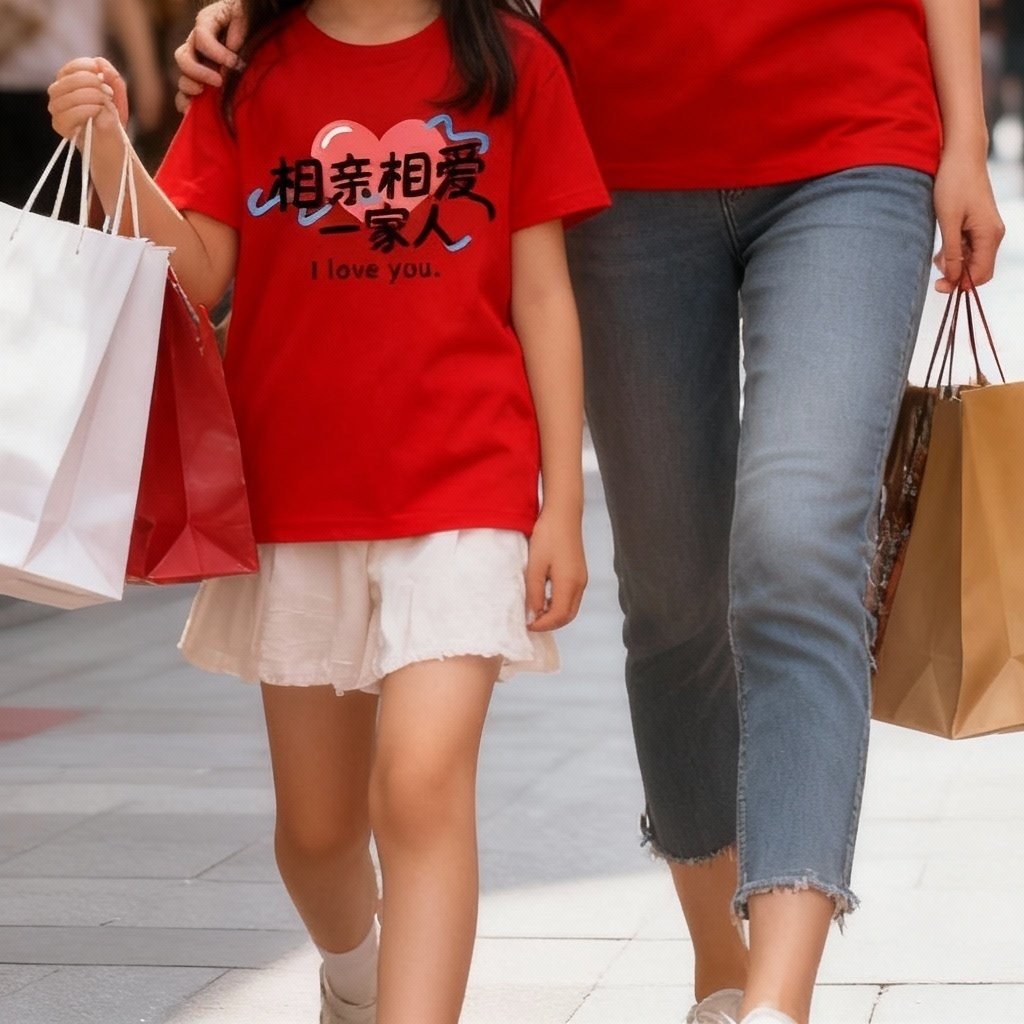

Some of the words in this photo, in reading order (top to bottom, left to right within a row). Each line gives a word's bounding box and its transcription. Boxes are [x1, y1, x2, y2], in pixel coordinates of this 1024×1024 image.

[269, 141, 496, 222] 相亲相爱
[319, 202, 455, 253] 一家人
[310, 260, 318, 281] I
[327, 257, 379, 280] love
[388, 260, 441, 285] you.
